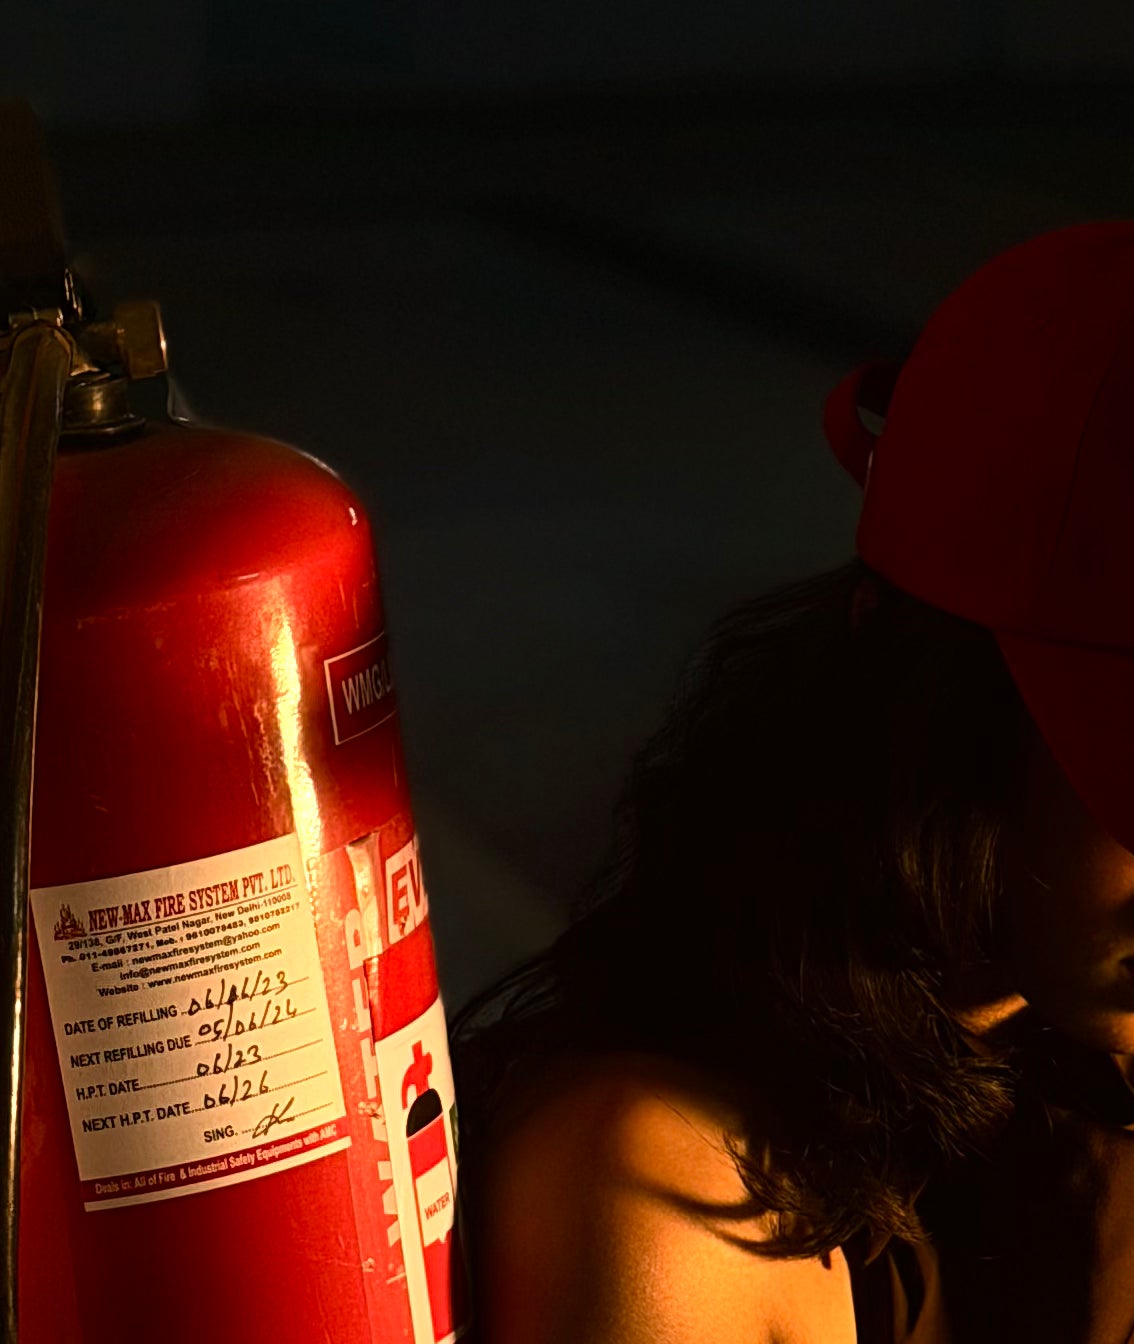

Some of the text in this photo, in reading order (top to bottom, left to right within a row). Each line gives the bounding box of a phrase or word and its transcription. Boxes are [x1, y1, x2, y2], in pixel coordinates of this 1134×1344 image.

[88, 864, 296, 932] NEW-MAX FIRE SYSTEM PVT. LTD.
[127, 928, 152, 940] West
[215, 910, 235, 921] New
[97, 984, 139, 997] Website
[64, 1005, 177, 1036] DATE OF REFILLING
[70, 1035, 192, 1068] NEXT REFILLING DUE
[197, 1043, 262, 1076] 06/23
[76, 1079, 140, 1101] H.P.T. DATE
[203, 1070, 269, 1109] 06/26
[82, 1102, 191, 1132] NEXT H.P.T. DATE
[203, 1125, 239, 1143] SING.
[148, 1174, 157, 1186] of
[159, 1172, 176, 1184] Fire
[188, 1157, 228, 1177] Industrial
[229, 1153, 255, 1168] Safety
[424, 1192, 450, 1220] WATER
